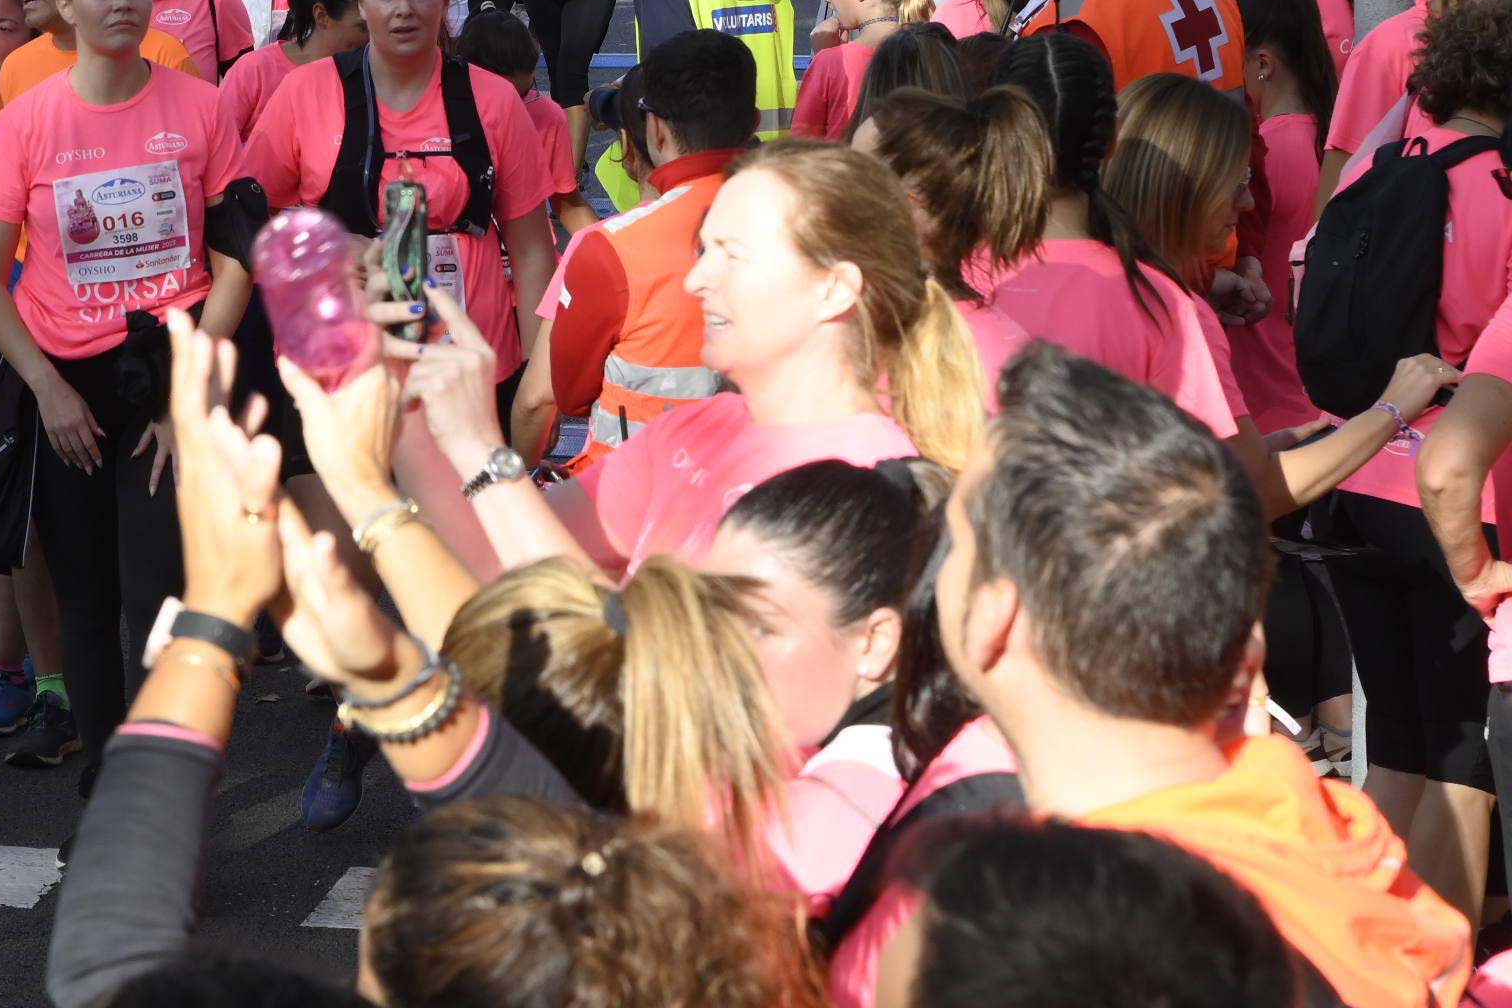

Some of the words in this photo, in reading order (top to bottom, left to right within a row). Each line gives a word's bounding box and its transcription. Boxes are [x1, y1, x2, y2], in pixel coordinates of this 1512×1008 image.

[55, 147, 106, 165] OYSHO
[95, 185, 143, 204] ASTURIANA
[102, 211, 145, 231] 016
[113, 232, 139, 244] 3598
[79, 249, 112, 259] CARRERA
[114, 248, 123, 257] DE
[124, 246, 133, 255] LA
[134, 244, 159, 255] MUJER
[78, 264, 116, 277] OYSHO
[145, 254, 181, 267] Santander
